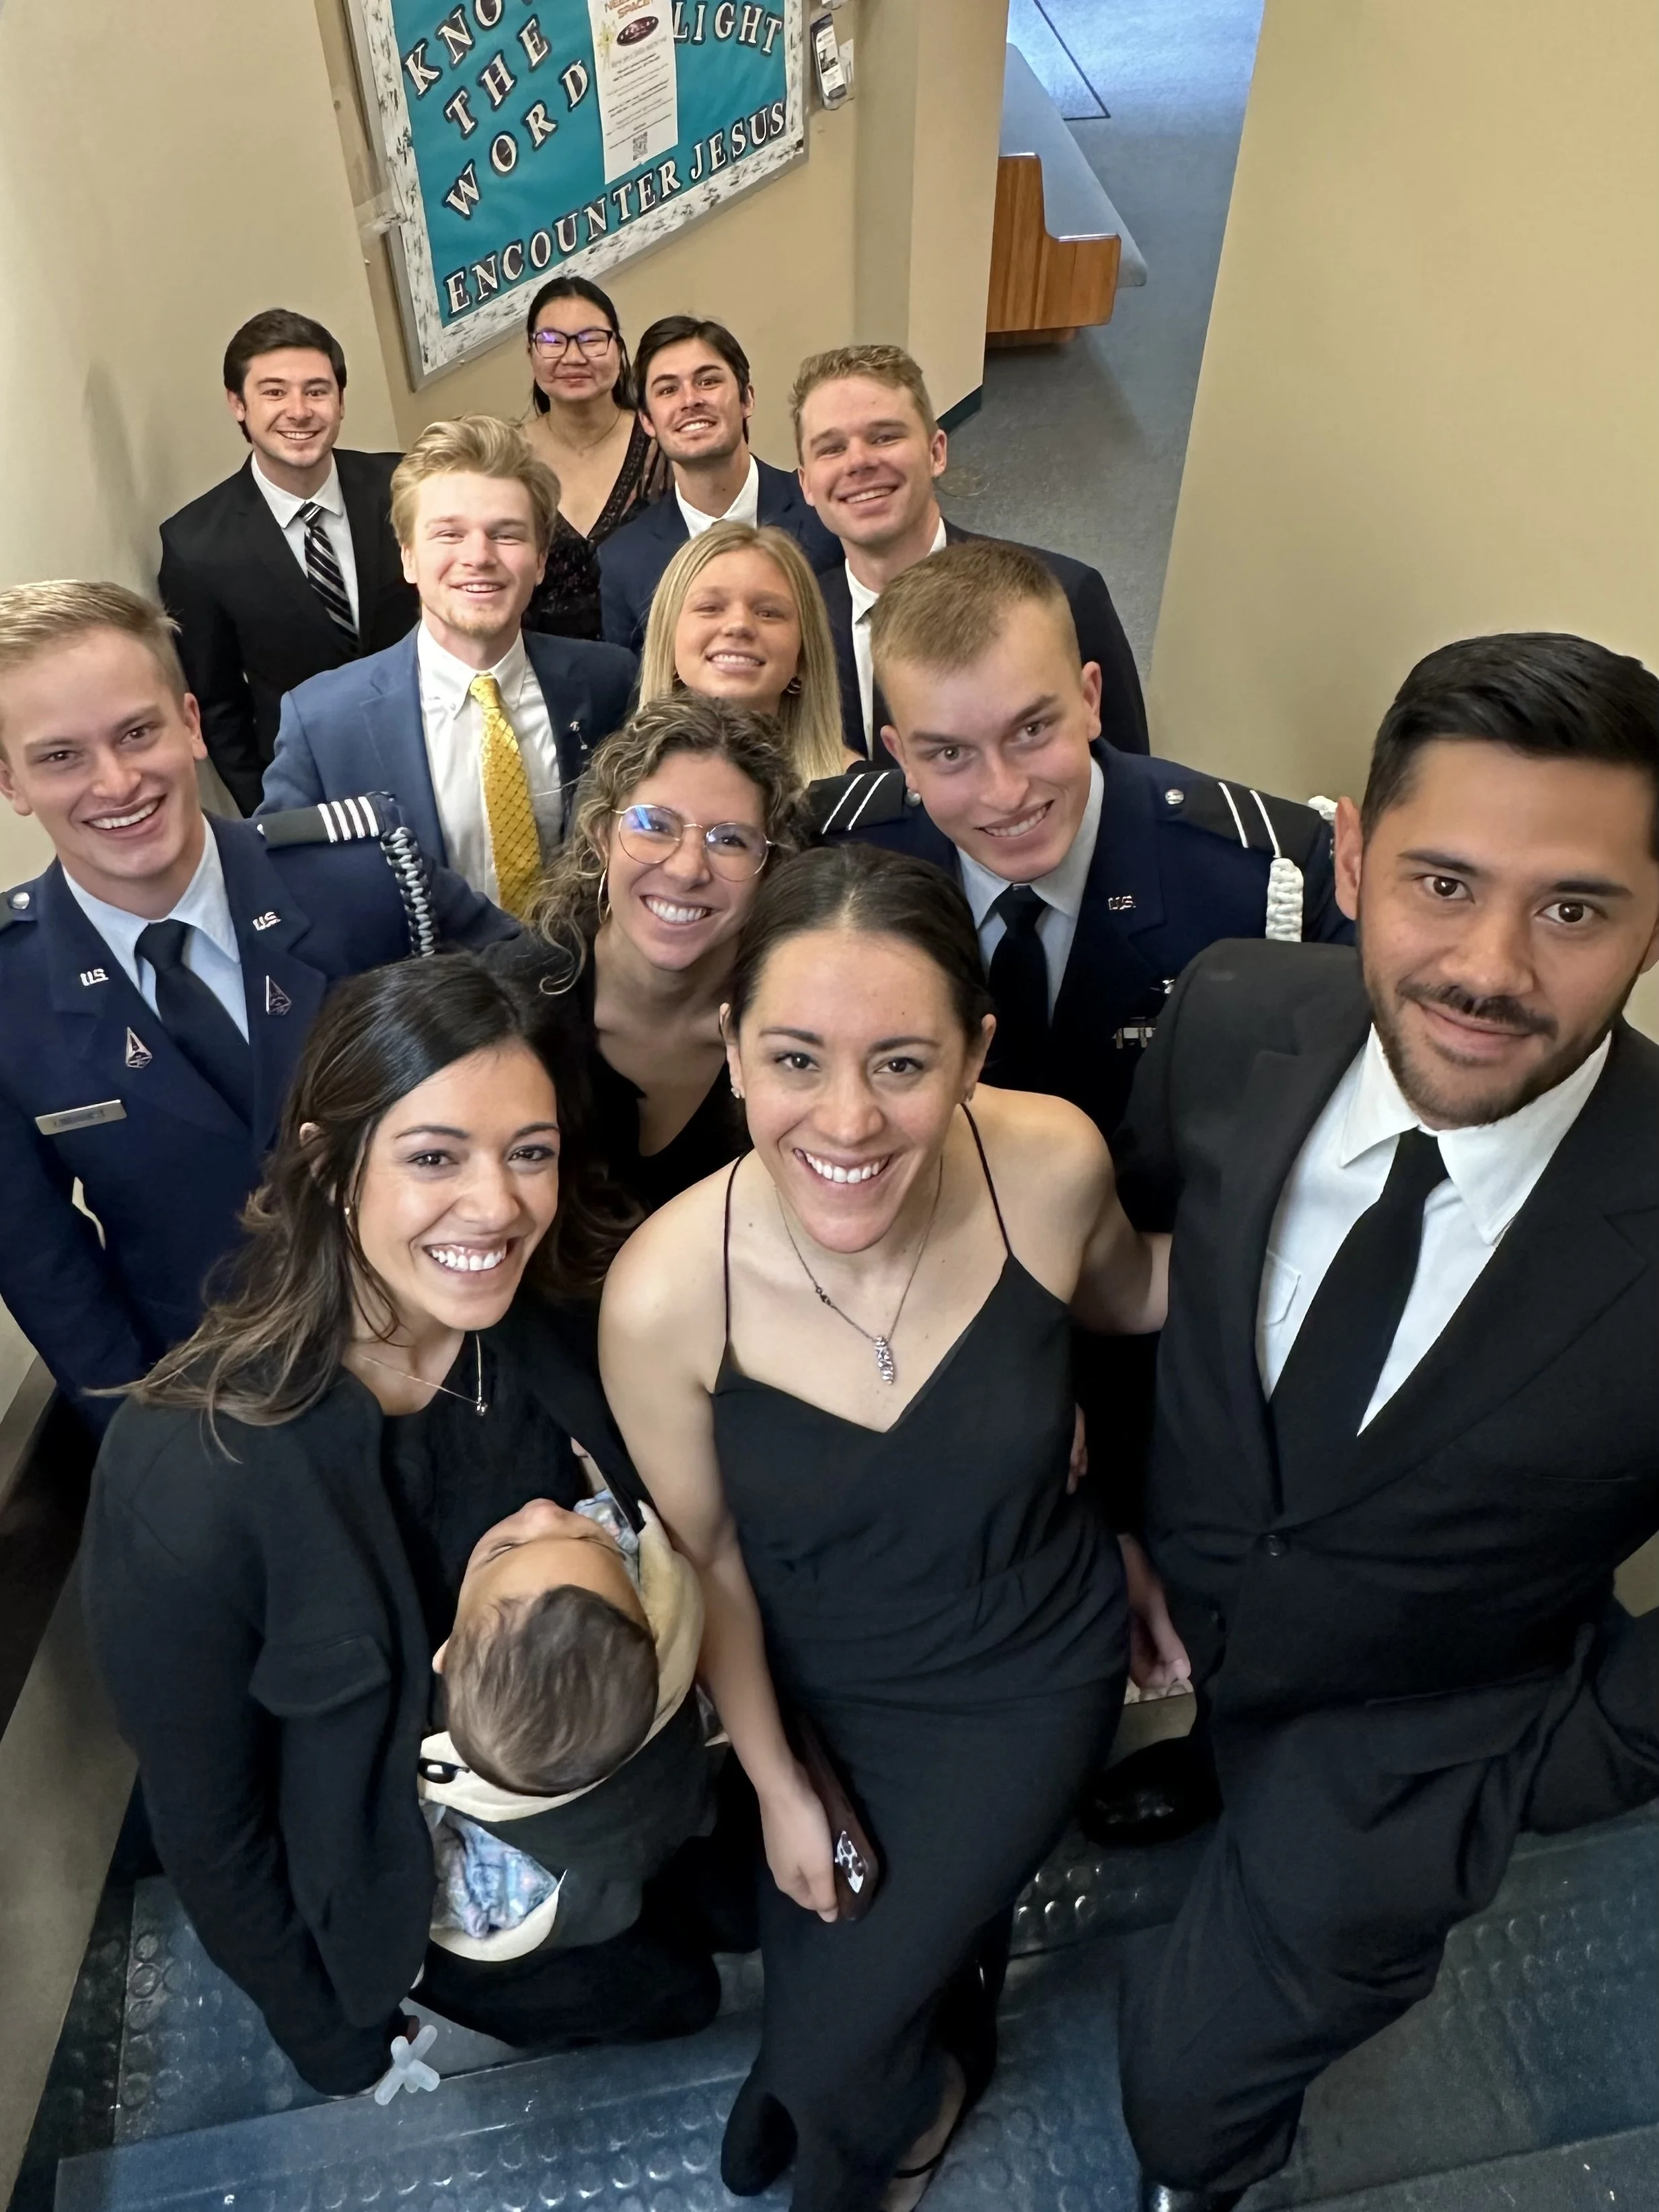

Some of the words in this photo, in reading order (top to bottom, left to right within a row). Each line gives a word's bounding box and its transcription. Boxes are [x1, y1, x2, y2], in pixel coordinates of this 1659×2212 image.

[404, 0, 533, 96] KNO
[444, 17, 549, 135] THE
[672, 1, 783, 53] LIGHT
[445, 59, 589, 217] WORD
[447, 160, 681, 314] ENCOUNTER
[690, 102, 785, 180] JESUS
